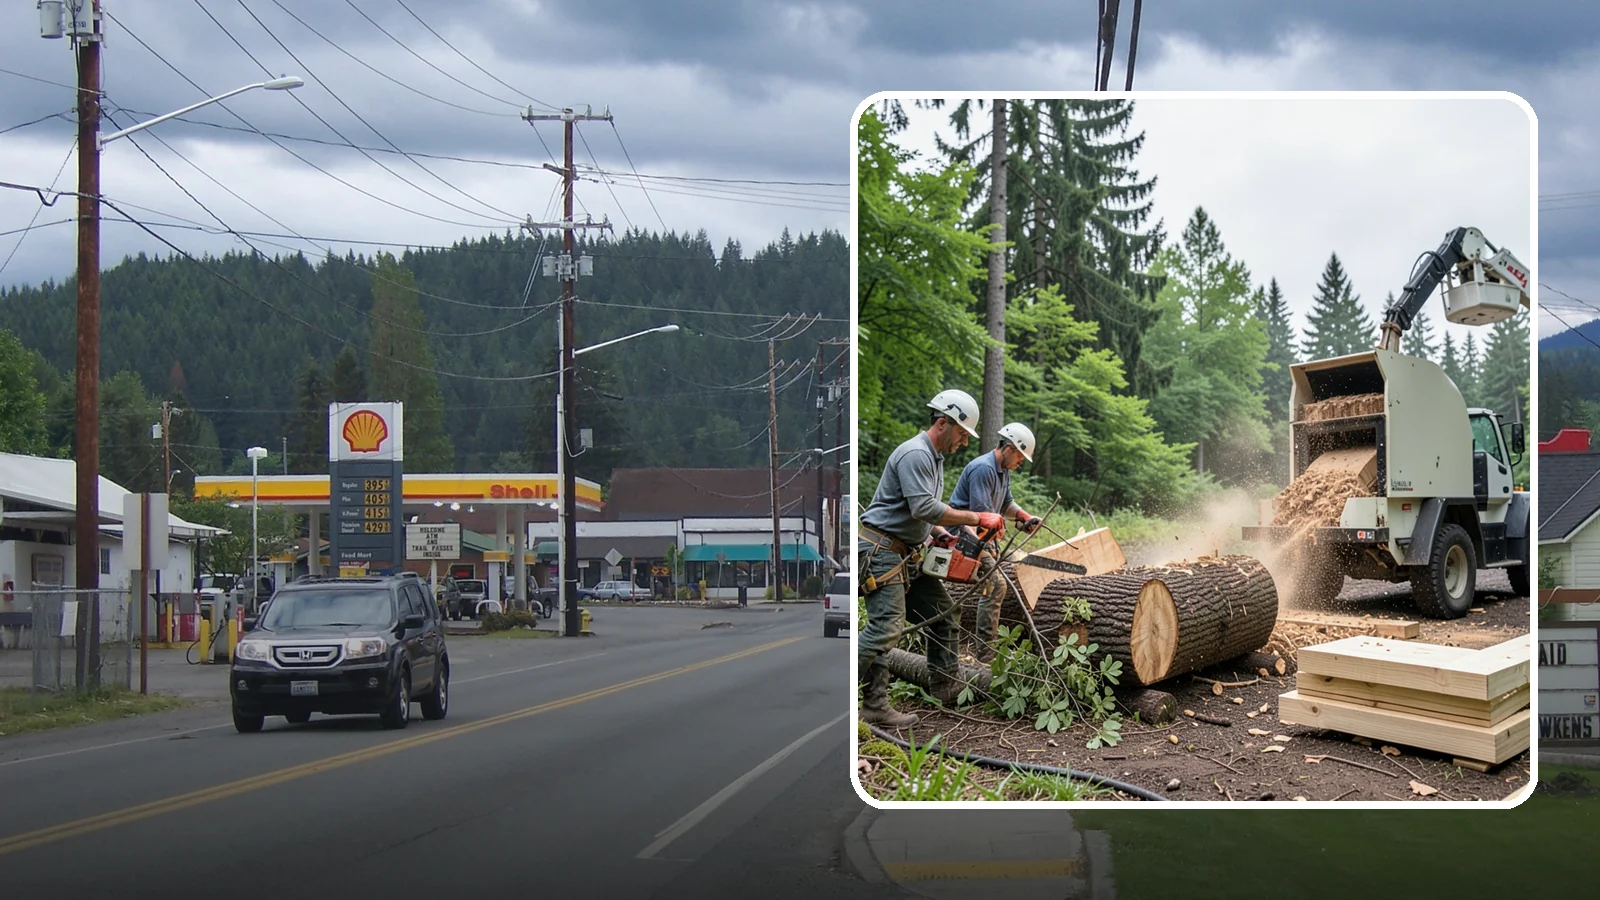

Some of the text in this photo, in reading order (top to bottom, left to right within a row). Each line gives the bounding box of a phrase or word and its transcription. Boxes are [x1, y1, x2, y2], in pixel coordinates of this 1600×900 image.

[366, 480, 383, 490] 395
[490, 484, 547, 499] Shell
[366, 494, 383, 504] 405
[366, 508, 383, 518] 415
[366, 522, 383, 532] 429
